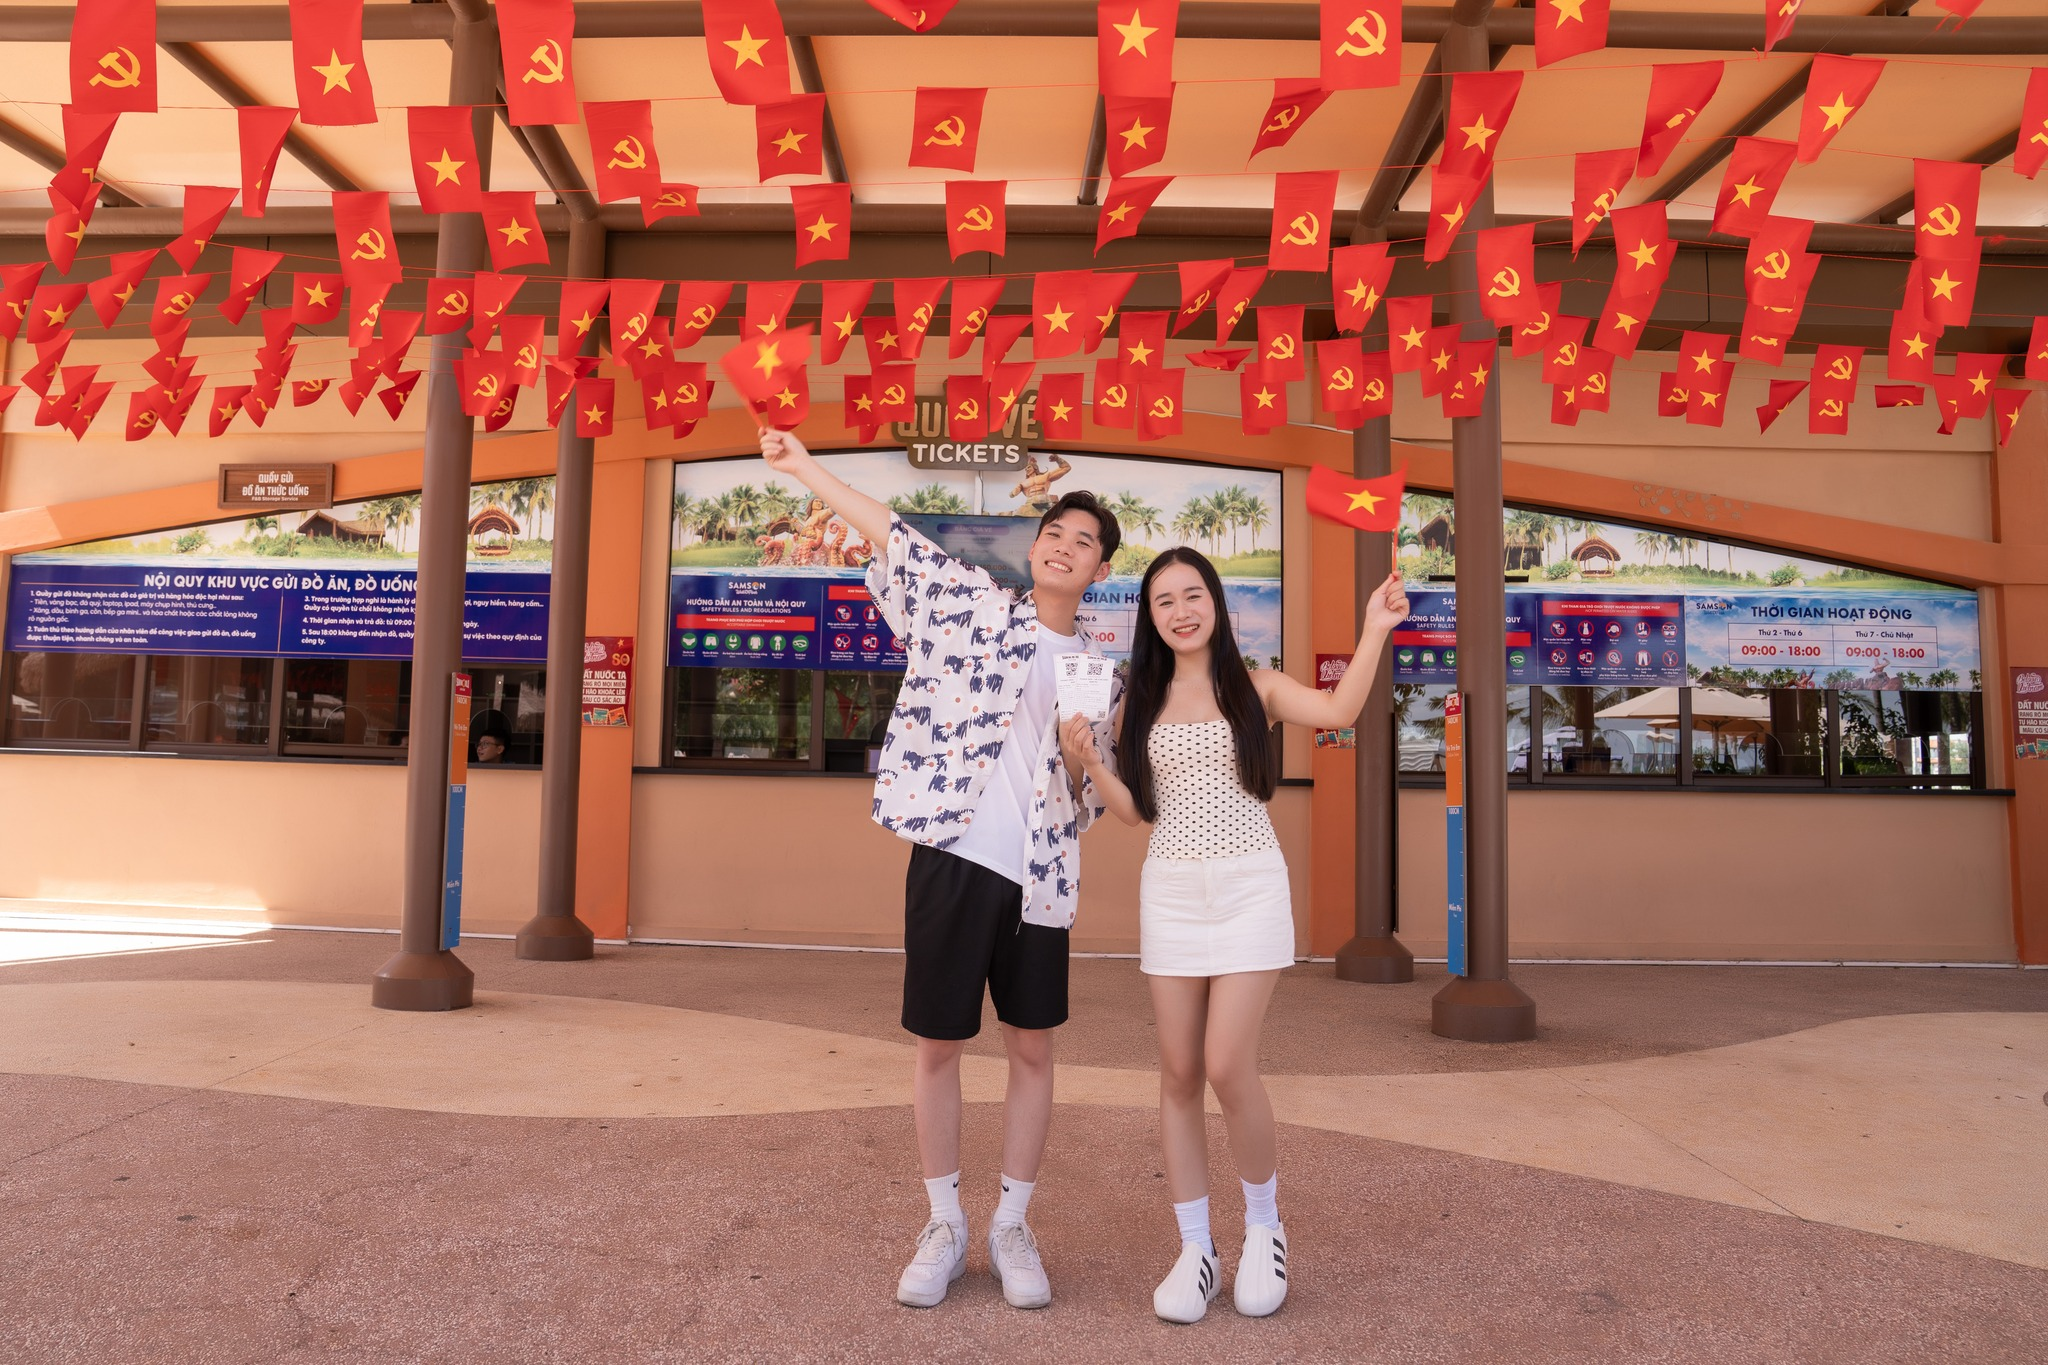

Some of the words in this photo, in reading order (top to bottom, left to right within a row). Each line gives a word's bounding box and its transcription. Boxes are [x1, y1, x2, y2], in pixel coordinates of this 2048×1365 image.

[913, 444, 1019, 464] TICKETS
[144, 572, 170, 590] NỘI
[174, 576, 204, 588] QUY
[208, 576, 236, 588] KHU
[240, 576, 269, 591] VỰC
[272, 574, 298, 589] GỬI
[302, 573, 324, 590] ĐỒ
[327, 575, 350, 592] ĂN,
[355, 574, 377, 590] ĐỒ
[728, 582, 766, 590] SAMSON
[686, 598, 713, 606] HƯỚNG
[715, 598, 730, 606] DẪN
[744, 599, 764, 607] TOÀN
[765, 599, 774, 607] VÀ
[776, 600, 789, 608] NỘI
[1083, 592, 1120, 603] GIAN
[1430, 614, 1445, 622] DẪN
[1751, 604, 1784, 617] THỜI
[1788, 607, 1824, 618] GIAN
[1828, 608, 1865, 622] HOẠT
[1869, 606, 1912, 622] ĐỘNG
[1091, 632, 1115, 642] :00
[1896, 632, 1913, 640] Nhật
[1742, 645, 1776, 655] 09:00
[1788, 646, 1821, 656] 18:00
[1846, 647, 1880, 657] 09:00
[1892, 648, 1925, 658] 18:00
[584, 668, 593, 679] ẤT
[617, 671, 626, 679] TA
